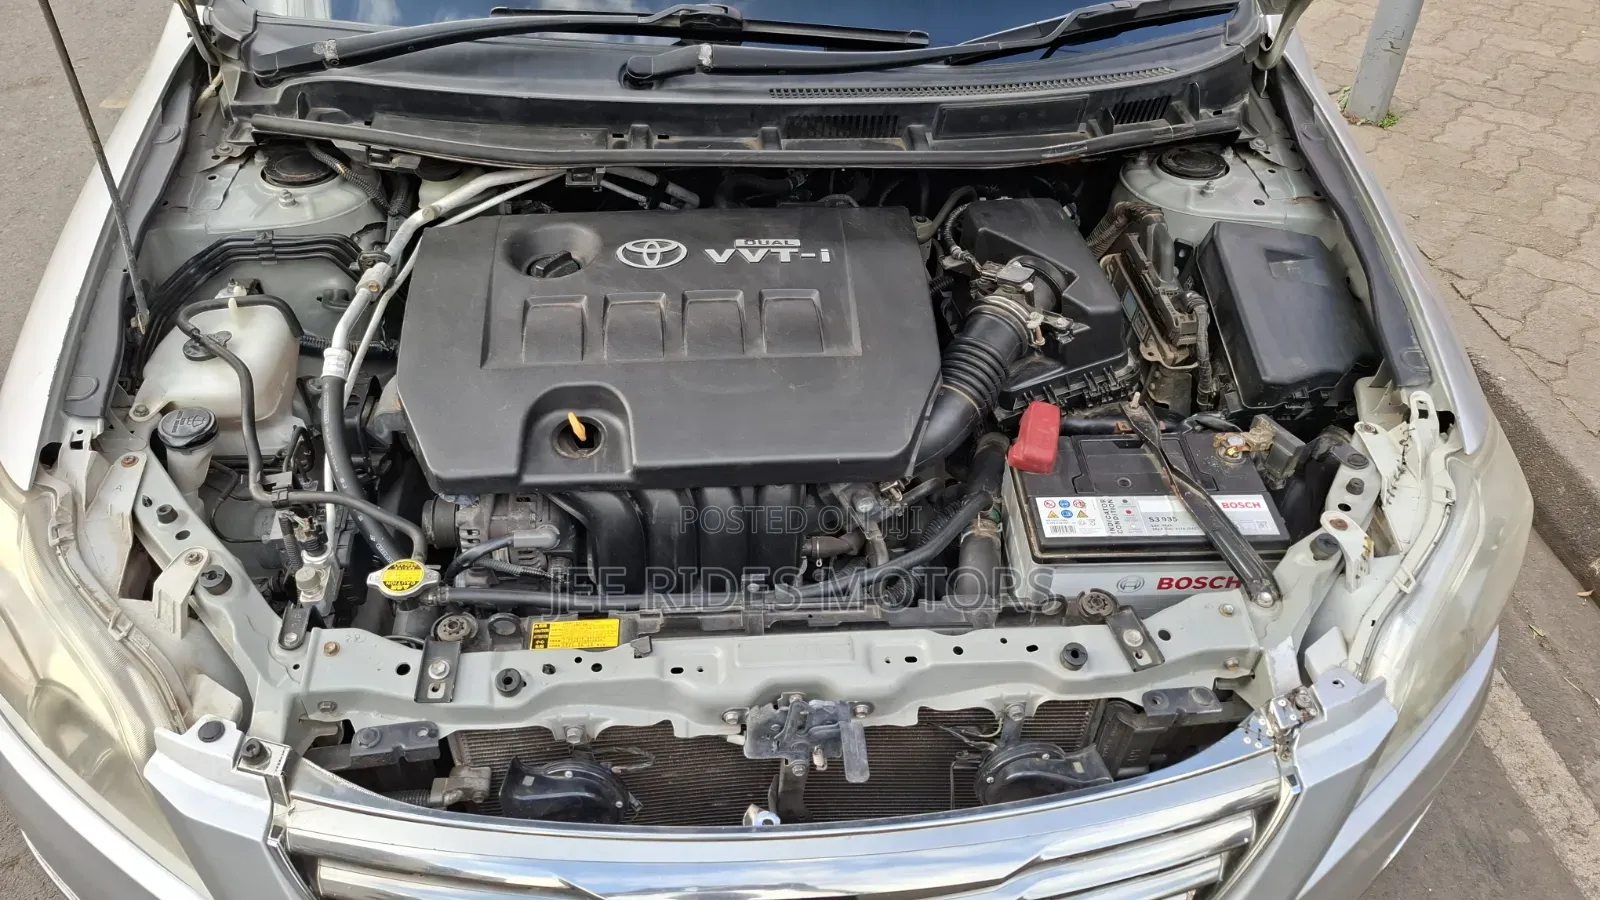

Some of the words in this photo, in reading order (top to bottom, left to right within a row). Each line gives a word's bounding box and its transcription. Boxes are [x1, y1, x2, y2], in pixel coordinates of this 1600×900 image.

[1100, 499, 1115, 534] INDICATOR
[1108, 499, 1123, 534] CONDITION
[1221, 501, 1262, 509] BOSCH
[1156, 576, 1241, 590] BOSCH
